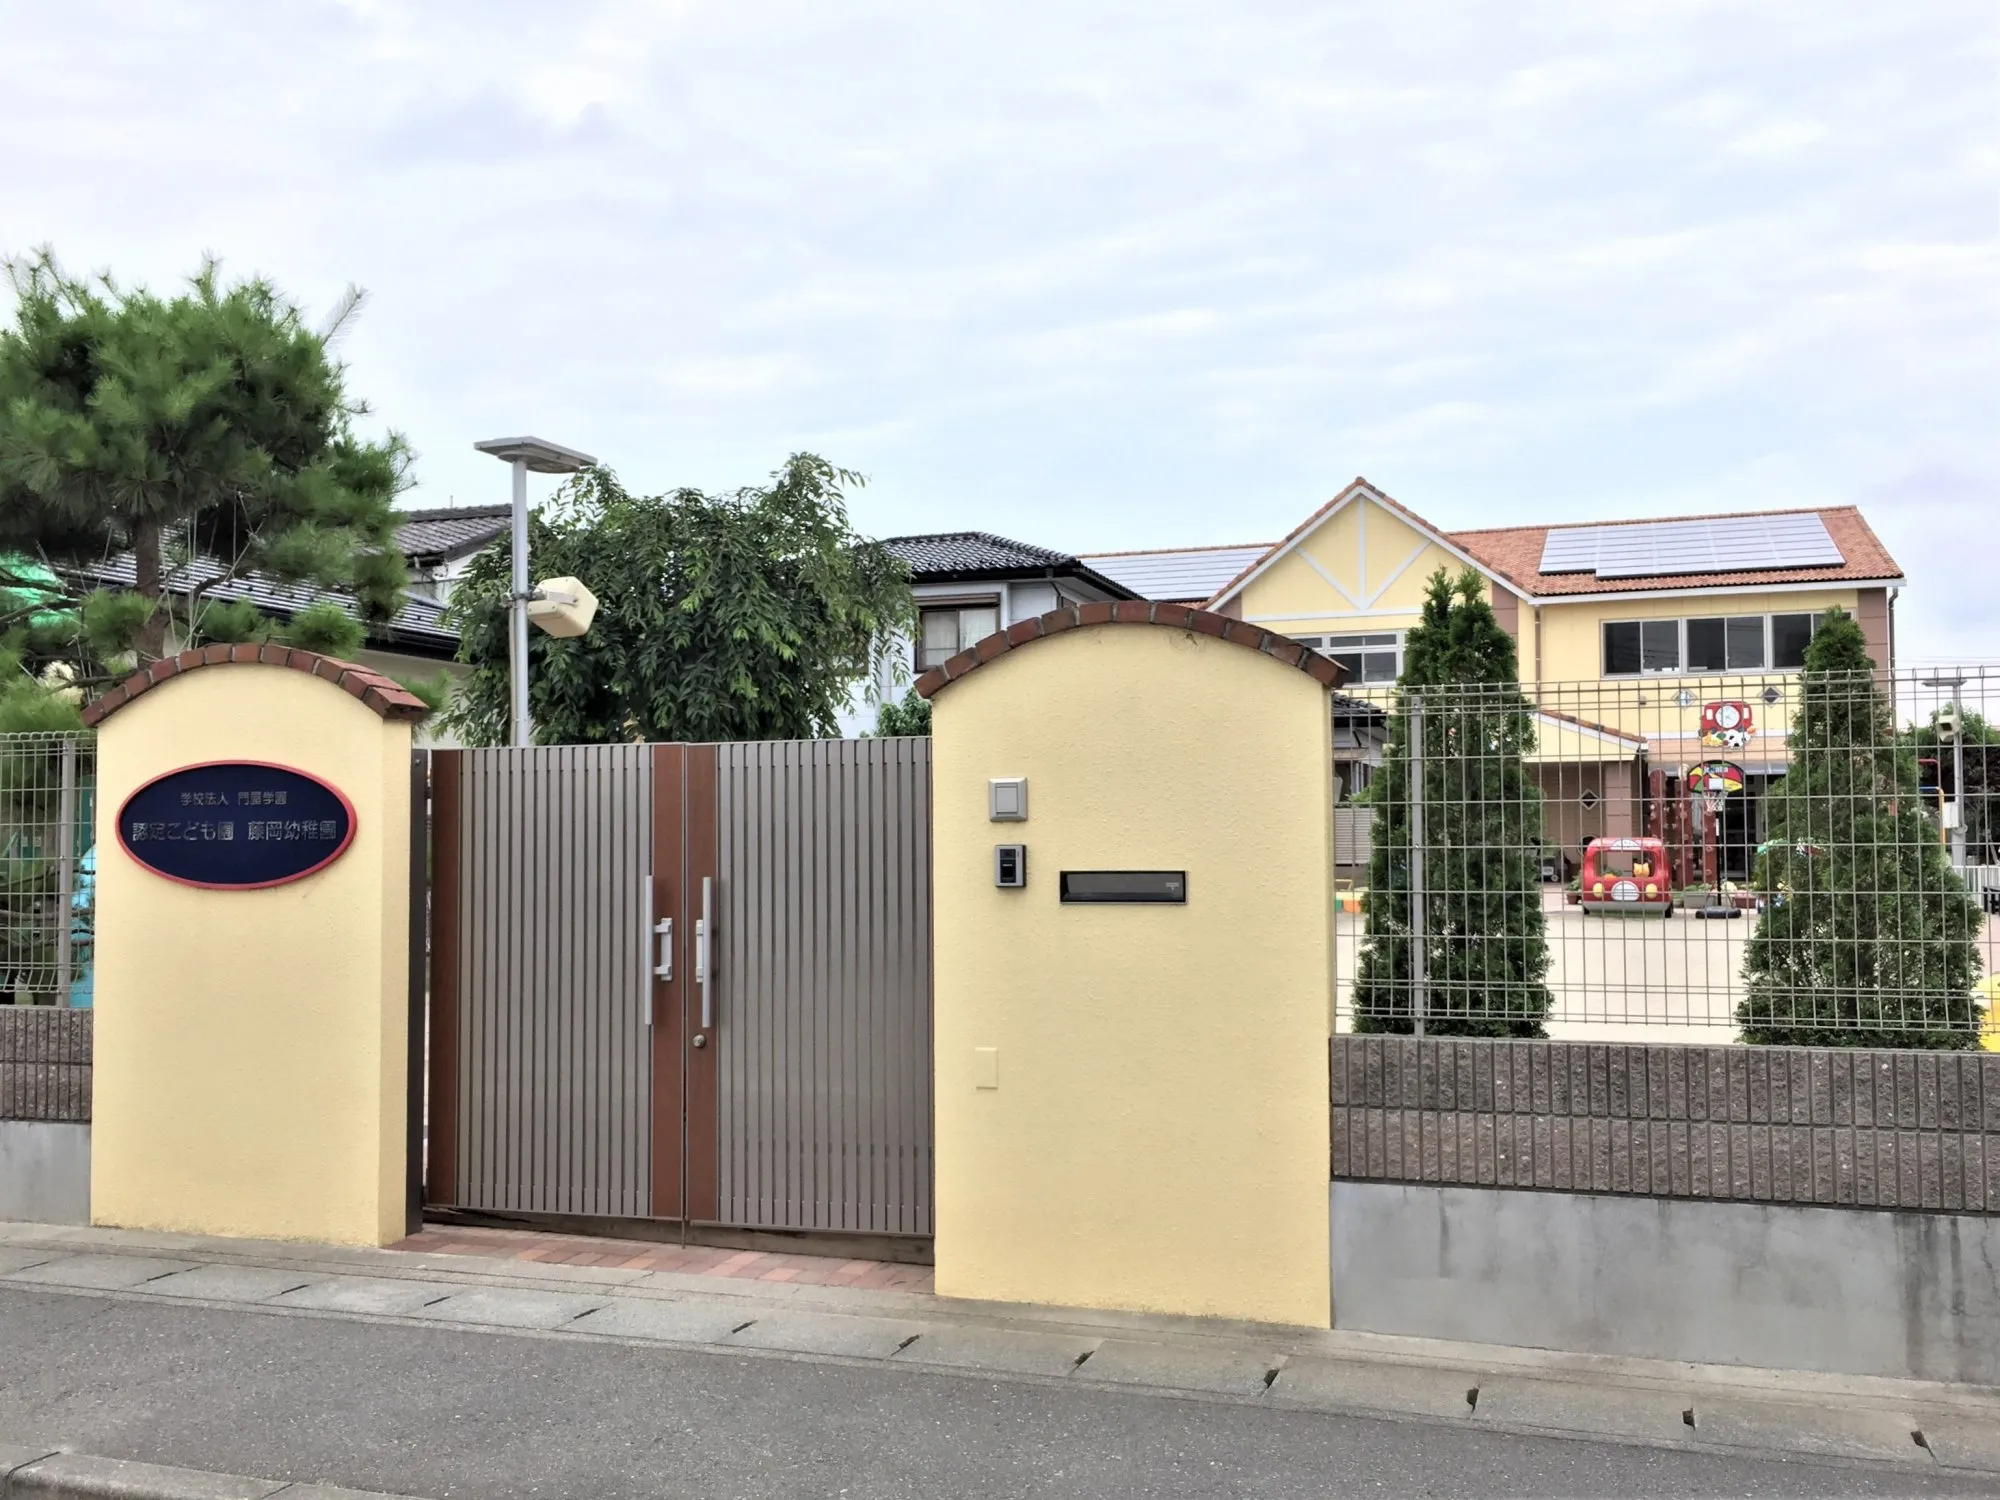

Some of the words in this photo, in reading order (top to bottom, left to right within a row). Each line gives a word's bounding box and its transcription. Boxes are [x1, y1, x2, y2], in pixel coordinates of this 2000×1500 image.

[180, 791, 229, 806] 学校法人
[132, 821, 234, 841] 認定こども園
[248, 820, 336, 841] 藤岡幼稚園
